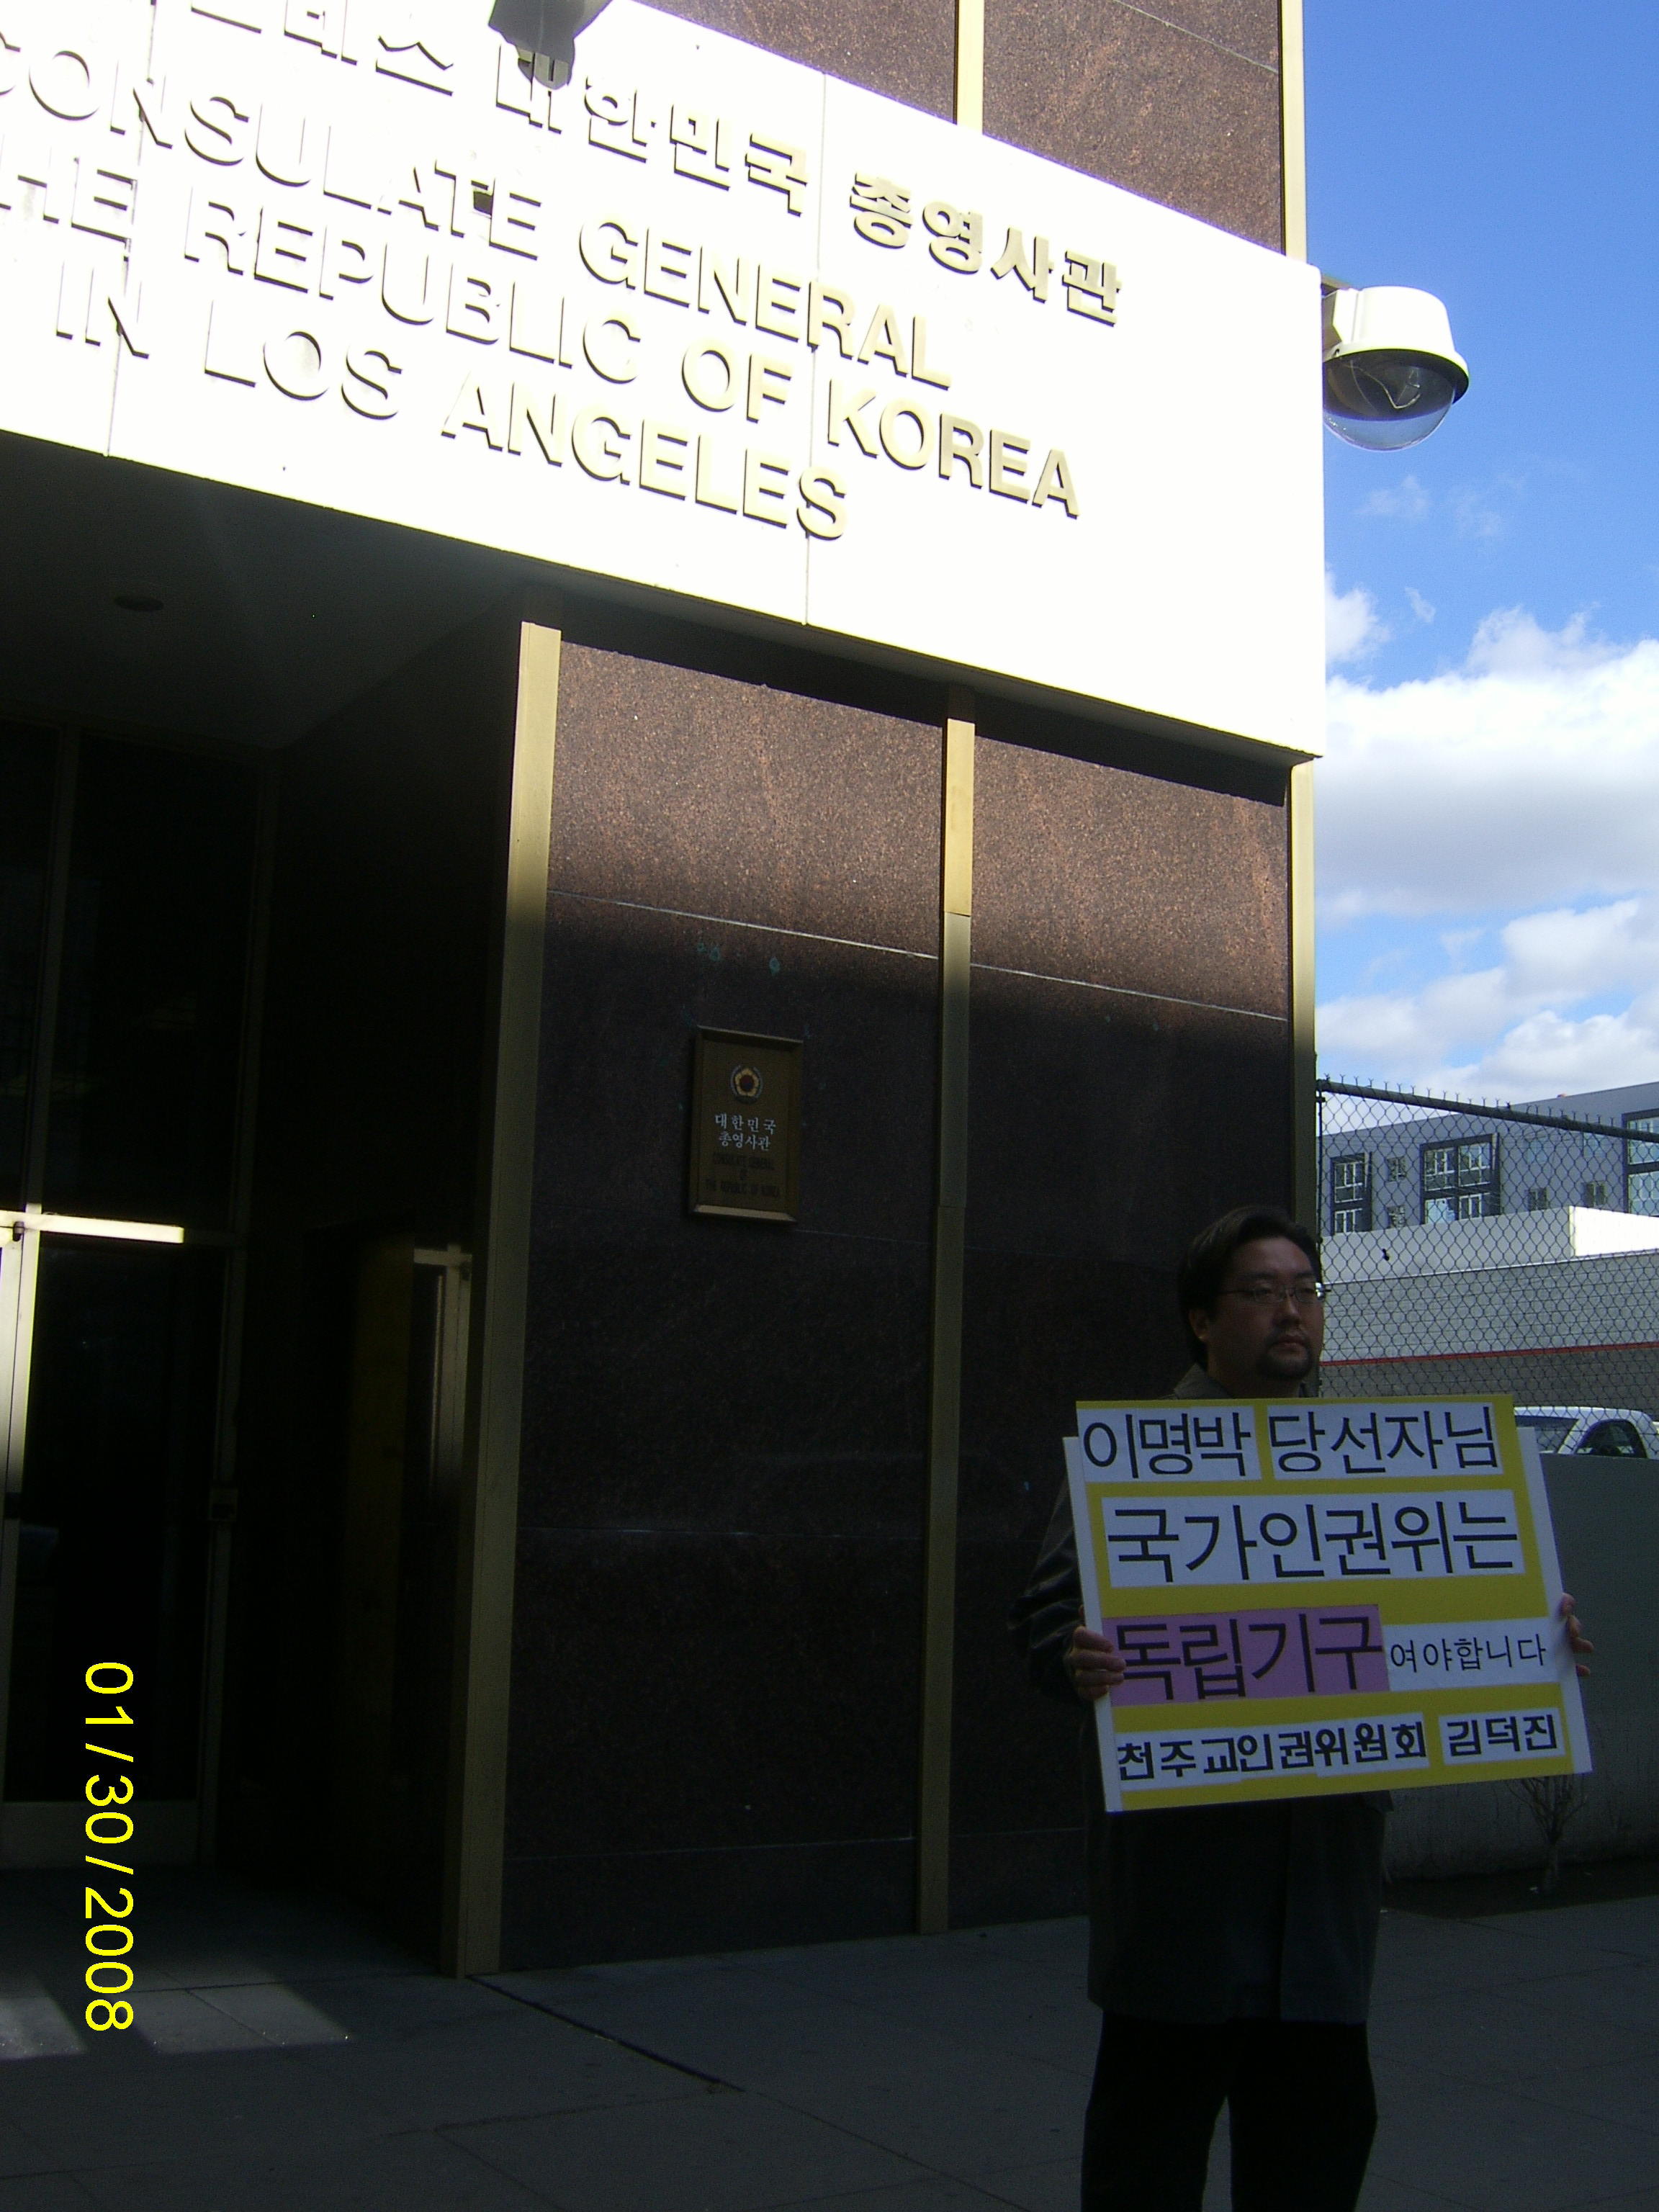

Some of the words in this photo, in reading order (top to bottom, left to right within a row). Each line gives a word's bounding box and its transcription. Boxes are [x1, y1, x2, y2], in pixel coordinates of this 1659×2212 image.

[579, 212, 953, 390] GENERAL
[184, 181, 642, 385] REPUBLIC
[681, 337, 794, 423] OF
[828, 377, 1079, 519] KOREA
[55, 256, 151, 360] IN
[204, 297, 403, 421] LOS
[441, 367, 848, 541] ANGELES
[714, 1112, 777, 1136] 대한민국
[1084, 1412, 1251, 1479] 이명박
[1267, 1406, 1498, 1475] 당선자님
[1107, 1500, 1518, 1583] 국가인권위는
[1116, 1613, 1383, 1700] 독립기구
[1390, 1633, 1547, 1673] 여야합니다
[1117, 1721, 1427, 1781] 천주교인권위원회
[1447, 1714, 1557, 1757] 김덕진
